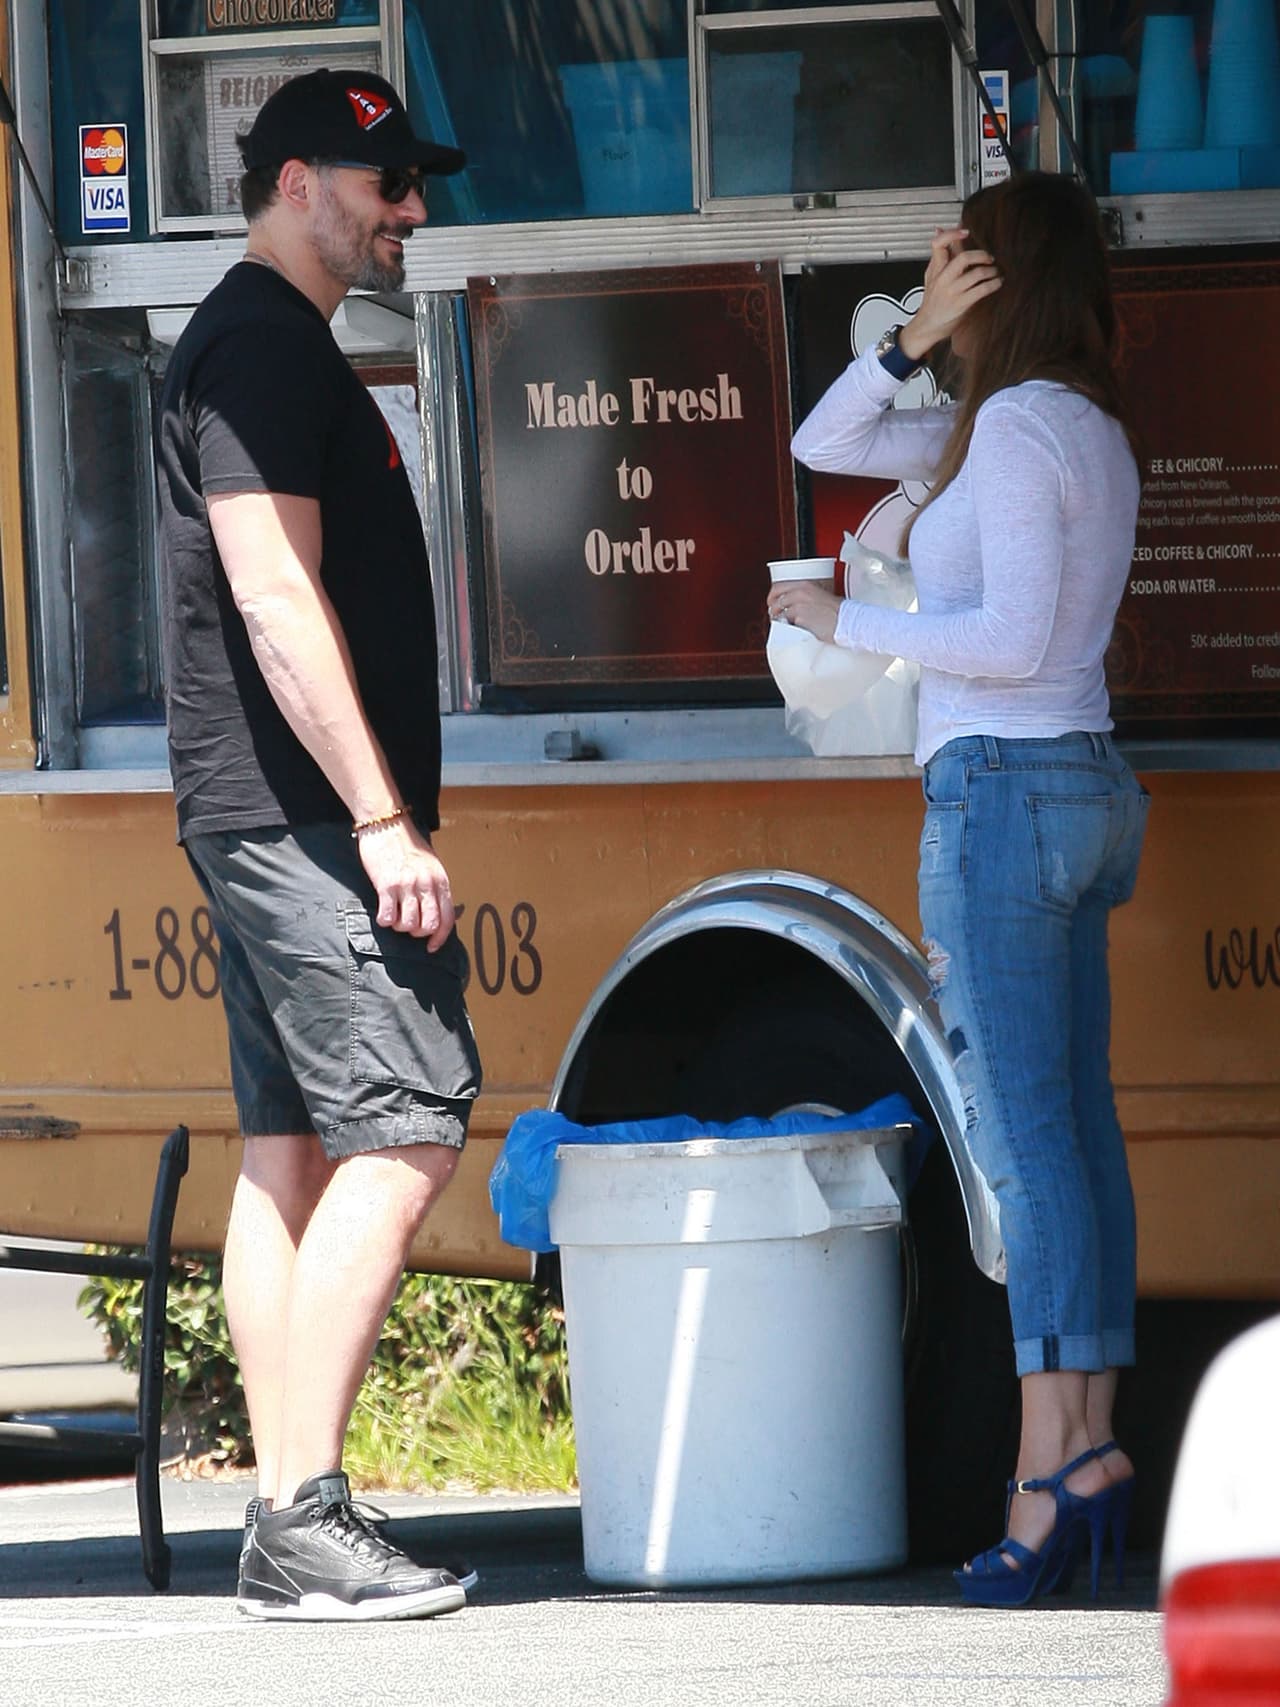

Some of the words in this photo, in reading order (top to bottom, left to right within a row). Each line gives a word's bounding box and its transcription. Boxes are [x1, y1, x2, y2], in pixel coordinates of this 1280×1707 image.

[220, 74, 294, 107] BEIGN
[84, 145, 124, 159] MasterCard
[88, 187, 125, 211] VISA
[525, 380, 620, 429] Made
[629, 373, 744, 424] Fresh
[1166, 459, 1175, 473] &
[1176, 457, 1224, 473] CHICORY
[616, 457, 653, 500] to
[1242, 494, 1254, 505] the
[584, 527, 696, 576] Order
[1155, 546, 1194, 560] COFFEE
[1196, 546, 1205, 560] &
[1206, 544, 1253, 559] CHICORY
[1130, 580, 1161, 595] SODA
[1163, 580, 1177, 594] OR
[1178, 578, 1216, 593] WATER
[1211, 633, 1242, 647] added
[1244, 633, 1254, 647] to
[454, 902, 542, 996] 03
